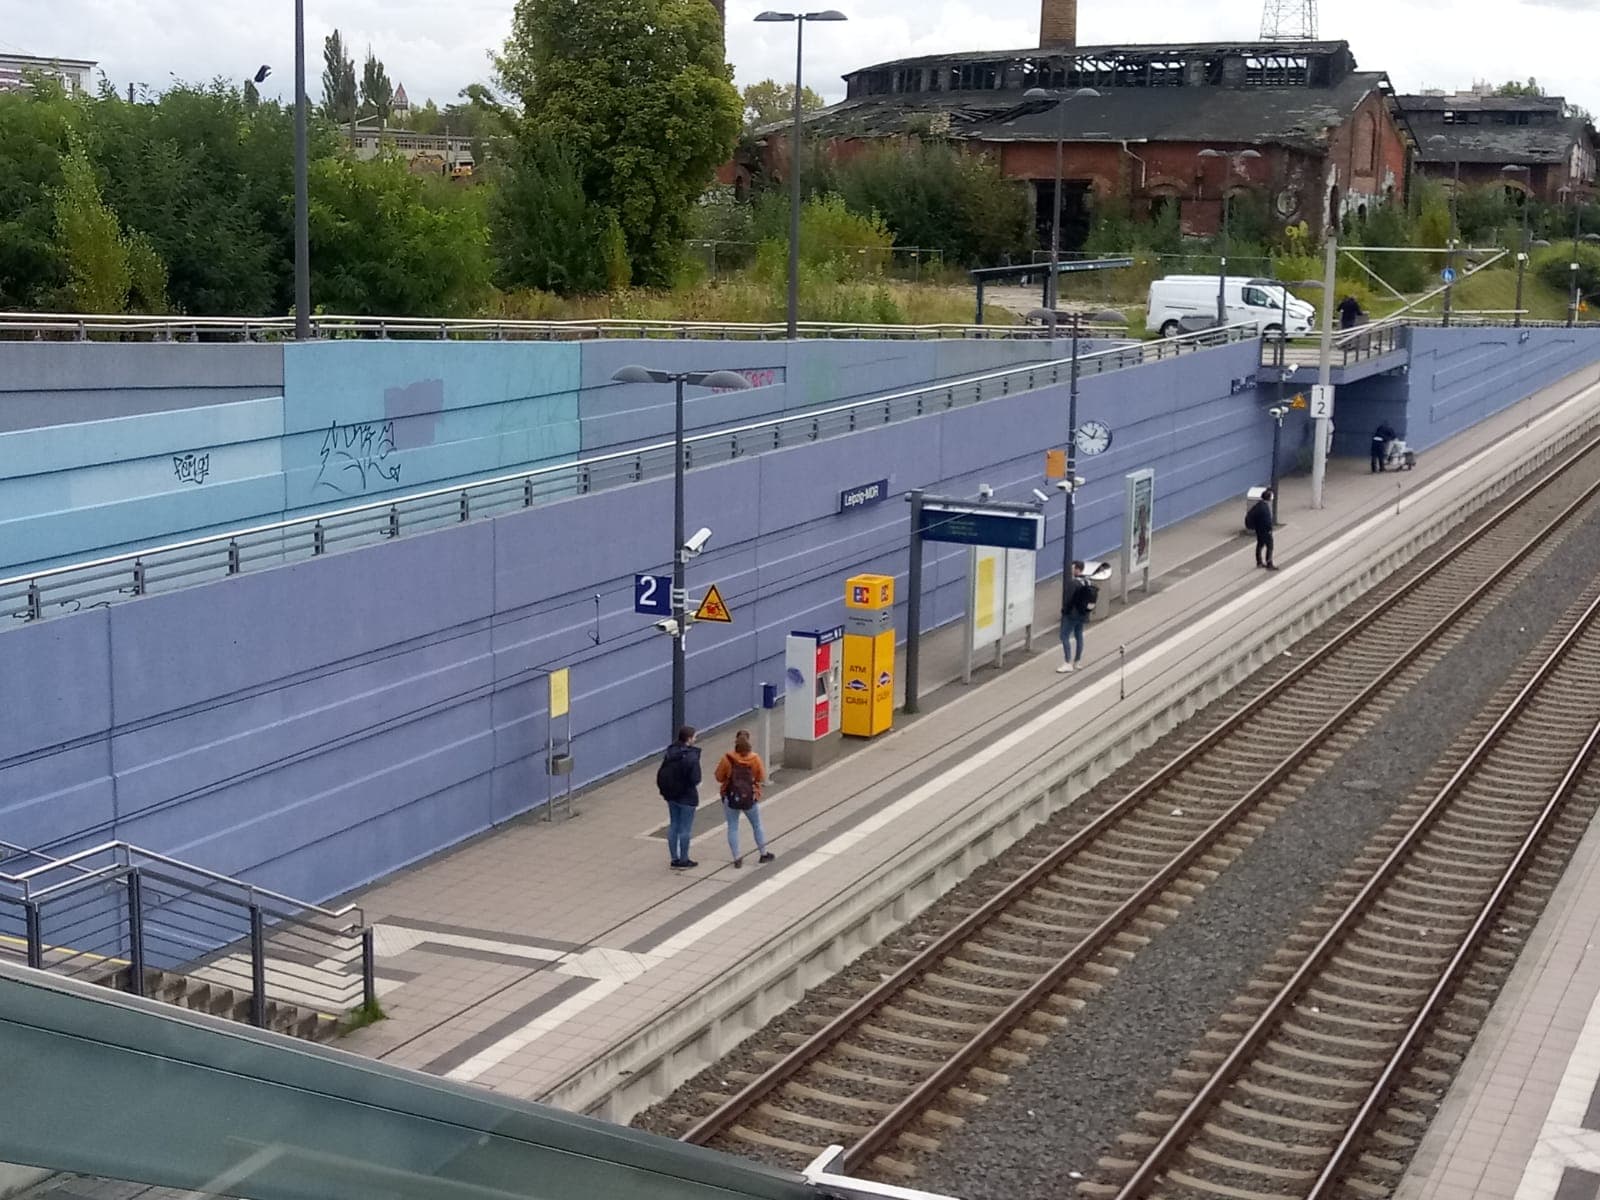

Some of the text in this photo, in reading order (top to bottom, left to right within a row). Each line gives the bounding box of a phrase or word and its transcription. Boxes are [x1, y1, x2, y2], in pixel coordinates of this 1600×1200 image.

[1317, 402, 1325, 415] 2
[845, 485, 879, 506] Leipzig-MDR
[640, 575, 657, 606] 2
[849, 665, 867, 673] ATM
[845, 696, 868, 705] CASH
